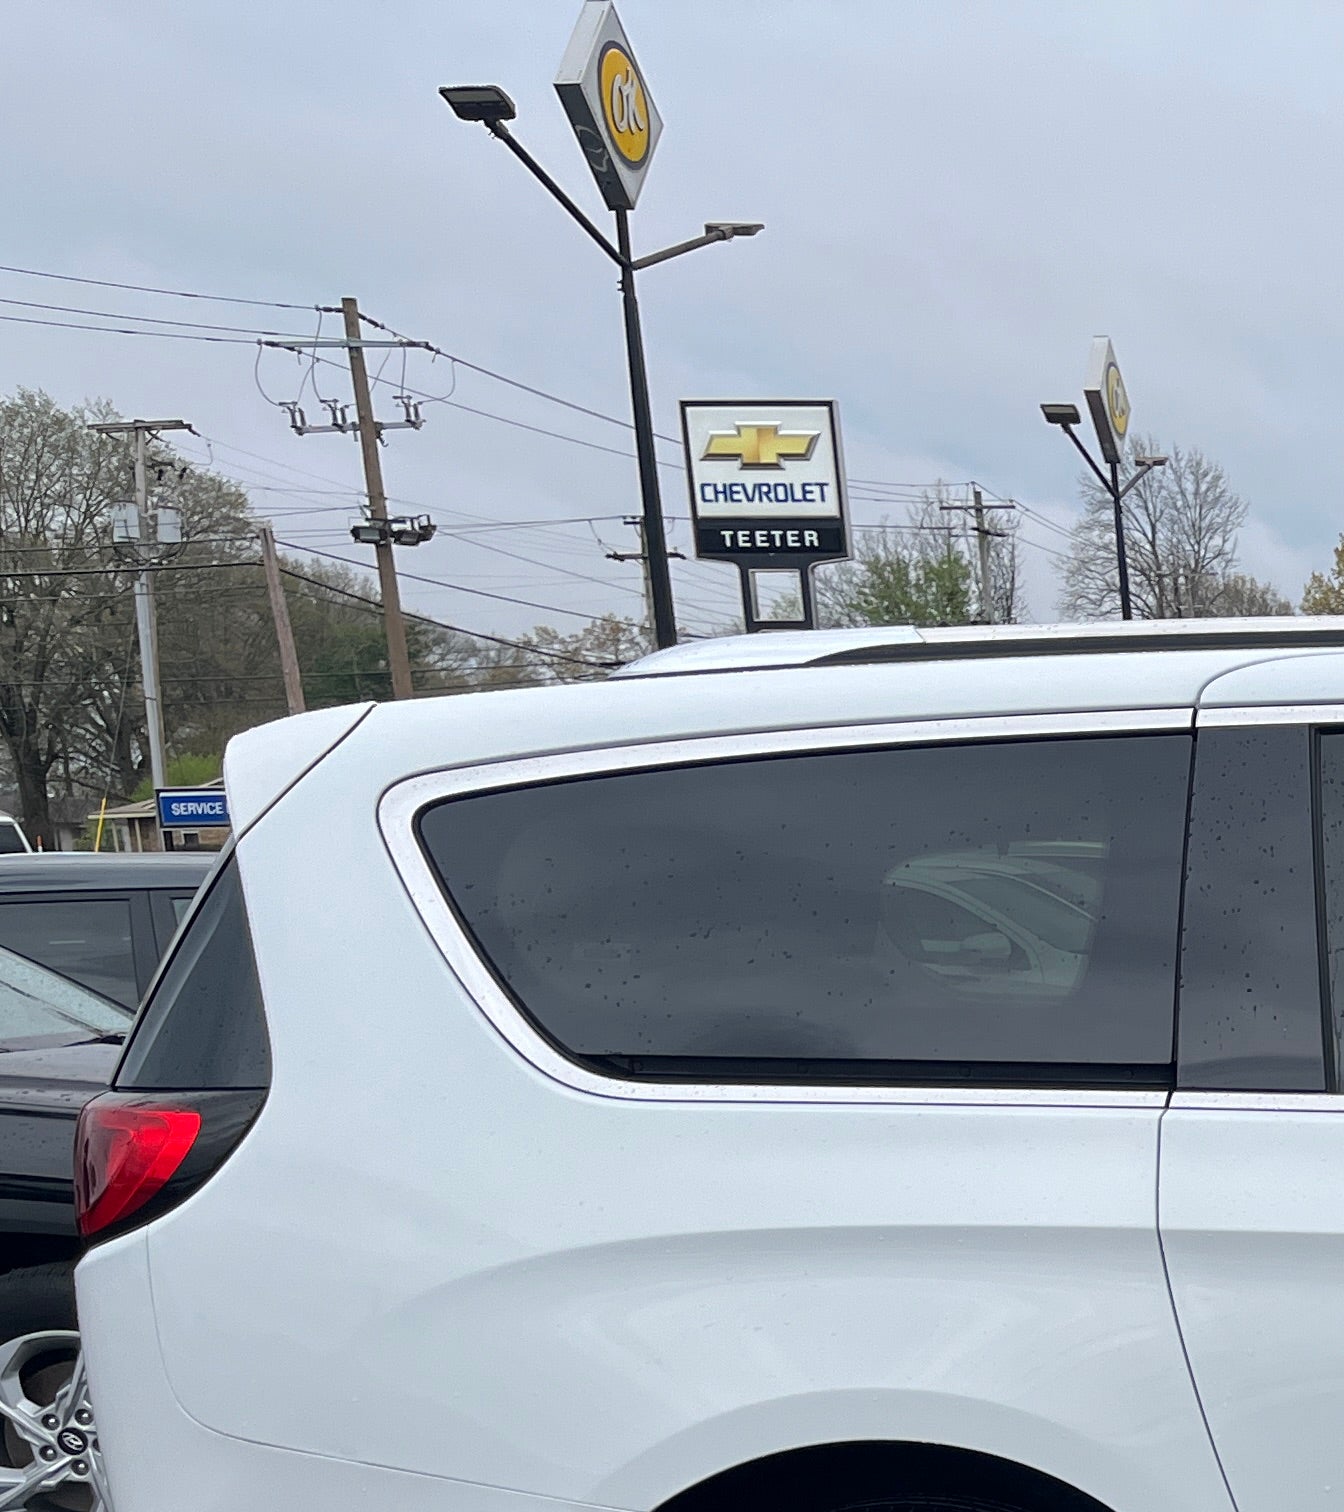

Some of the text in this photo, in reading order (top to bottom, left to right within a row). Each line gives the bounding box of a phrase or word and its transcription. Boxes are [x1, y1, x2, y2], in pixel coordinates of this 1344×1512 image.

[612, 66, 644, 135] OK
[699, 482, 829, 503] CHEVROLET
[720, 530, 819, 548] TEETER
[171, 801, 224, 816] SERVICE
